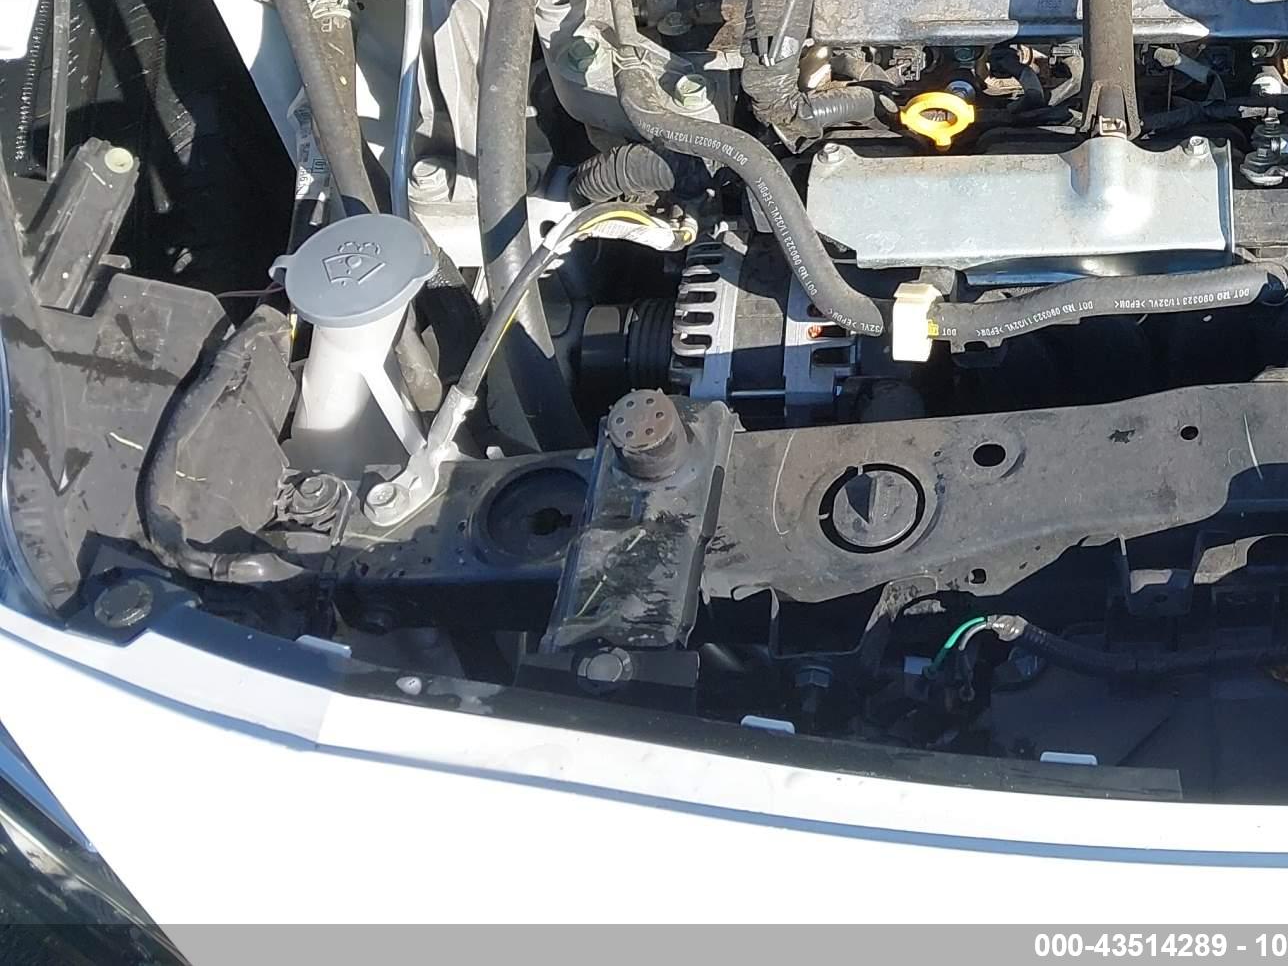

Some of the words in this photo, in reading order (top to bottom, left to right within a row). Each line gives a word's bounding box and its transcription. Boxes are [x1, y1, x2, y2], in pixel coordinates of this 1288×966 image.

[1233, 288, 1250, 298] DOT
[1182, 294, 1214, 305] 090323
[942, 328, 957, 336] DOT
